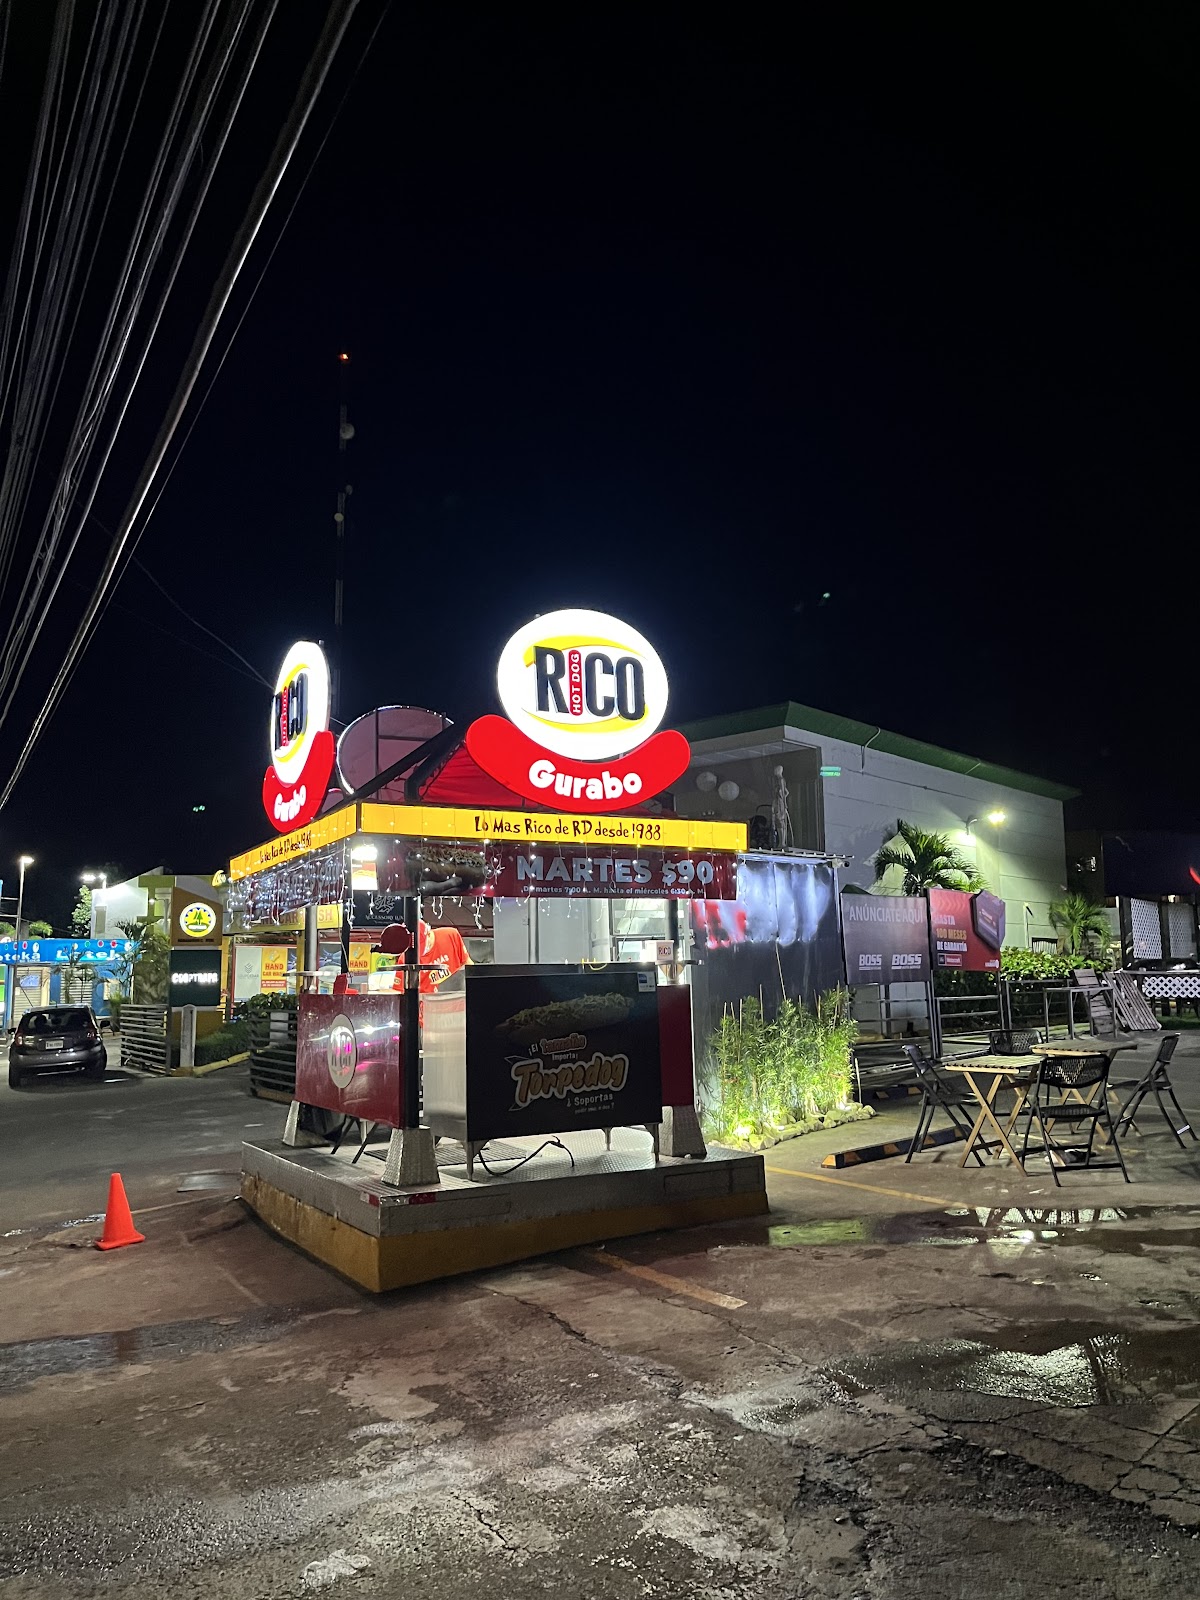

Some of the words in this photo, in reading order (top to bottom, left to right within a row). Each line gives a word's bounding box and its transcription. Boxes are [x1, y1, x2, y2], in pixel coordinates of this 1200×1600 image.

[570, 653, 581, 683] DOG
[533, 645, 646, 721] RICO
[571, 686, 582, 715] HOT
[529, 760, 643, 800] Gurabo
[474, 816, 489, 832] Lo
[493, 818, 521, 834] Mas
[525, 819, 552, 835] Rico
[554, 819, 570, 835] de
[572, 820, 593, 836] RD
[594, 821, 629, 838] desde
[632, 823, 661, 840] 1988
[517, 855, 652, 884] MARTES
[662, 859, 714, 886] $90
[850, 904, 900, 923] ANÚNCIATE
[859, 954, 882, 966] BOSS
[892, 954, 922, 966] BOSS
[512, 1053, 628, 1106] Torpedog
